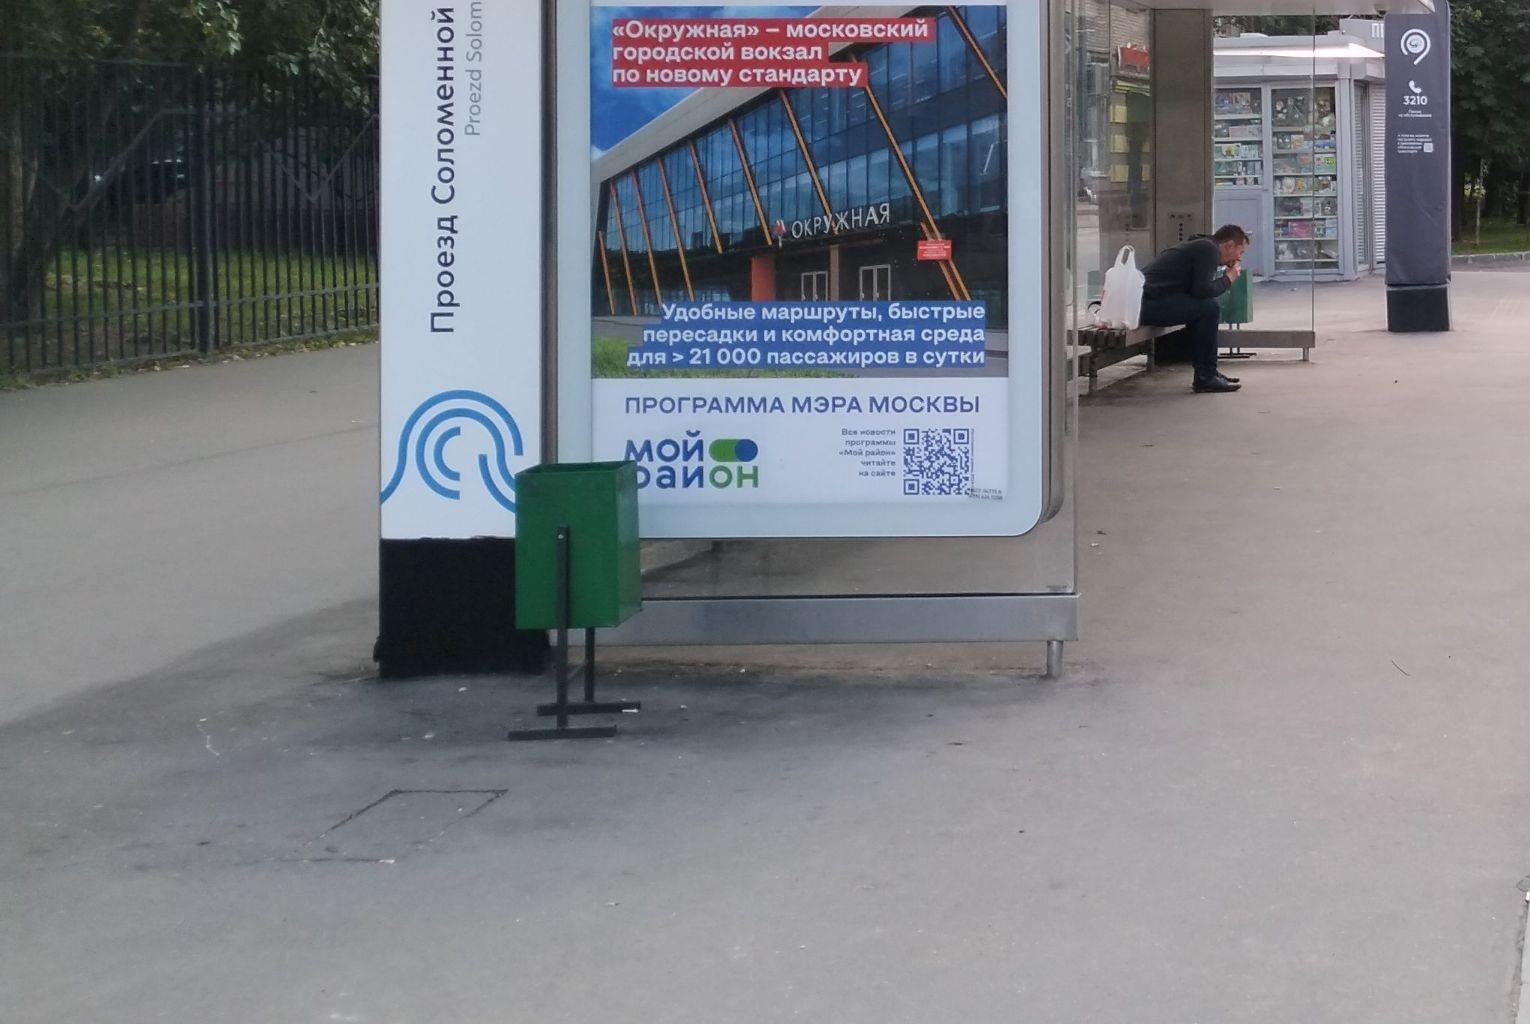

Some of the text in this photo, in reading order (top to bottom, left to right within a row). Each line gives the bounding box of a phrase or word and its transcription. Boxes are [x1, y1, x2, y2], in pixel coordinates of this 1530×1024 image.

[612, 21, 759, 41] «Окружная»
[786, 19, 928, 38] московский
[612, 43, 822, 63] городской вокзал
[612, 67, 862, 87] по новому стандарту
[430, 7, 455, 204] Соломенной
[464, 69, 482, 136] Proezd
[1403, 95, 1428, 106] 3210
[791, 203, 890, 239] ОКРУЖНАЯ
[430, 215, 460, 333] Проезд
[662, 303, 985, 323] Удобные маршруты, быстрые
[643, 325, 985, 345] пересадки и комфортная среда
[627, 350, 666, 367] для
[689, 348, 712, 364] 21
[716, 348, 761, 364] 000
[767, 349, 900, 368] пассажиров
[905, 350, 914, 364] в
[920, 349, 985, 367] сутки
[625, 395, 980, 414] ПРОГРАММА МЭРА МОСКВЫ
[841, 428, 858, 436] Все
[624, 429, 704, 462] мой
[845, 440, 896, 448] программы
[860, 459, 896, 467] читайте
[870, 469, 896, 477] сайте
